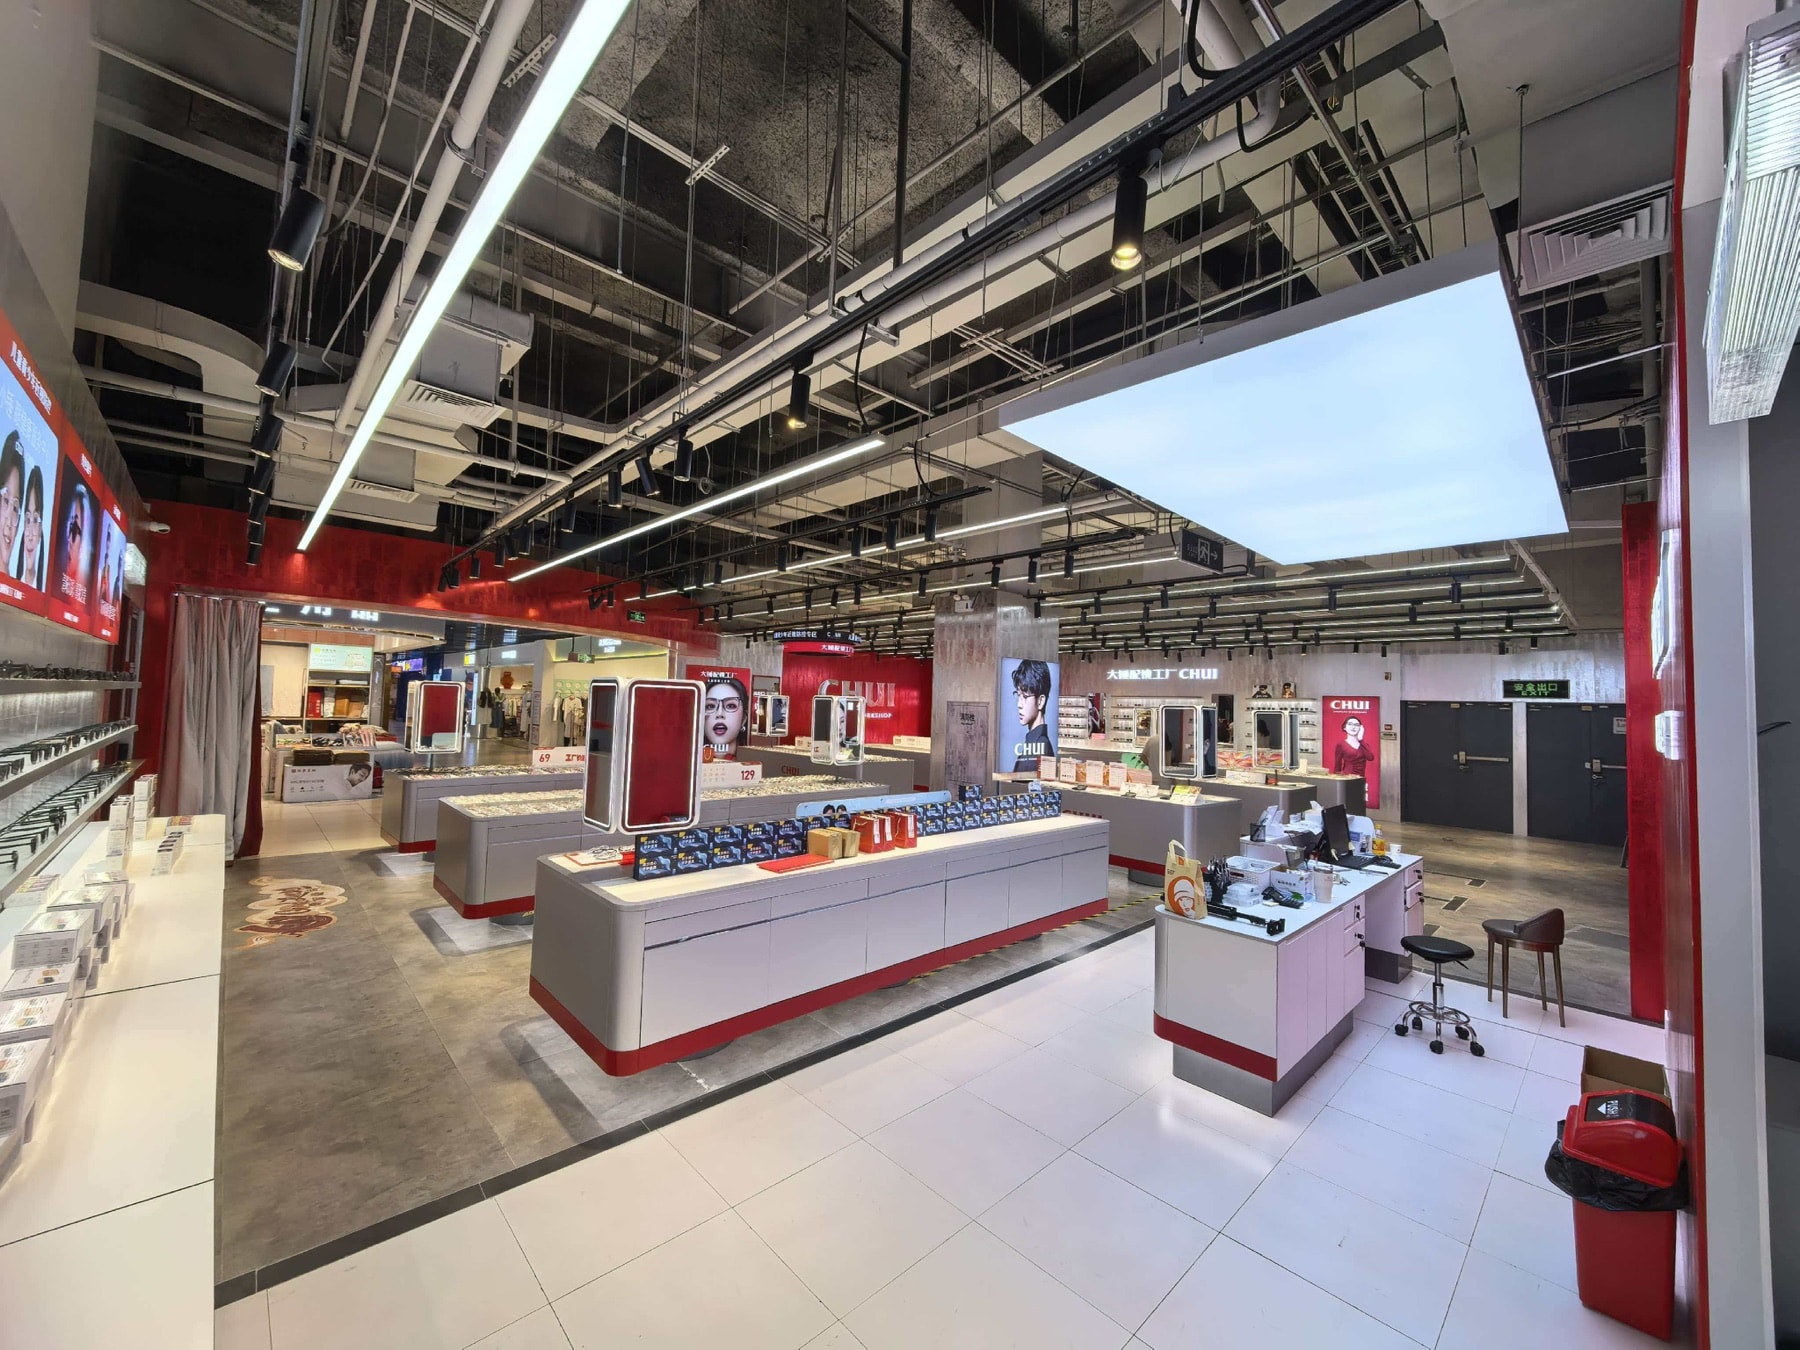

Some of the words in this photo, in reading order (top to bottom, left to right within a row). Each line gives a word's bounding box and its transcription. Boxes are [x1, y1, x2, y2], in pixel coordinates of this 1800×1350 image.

[1178, 668, 1218, 680] CHUI
[1513, 682, 1558, 691] 安全出口
[1330, 700, 1370, 710] CHUI
[1014, 742, 1045, 756] CHUI
[539, 753, 551, 763] 69
[741, 770, 755, 780] 129
